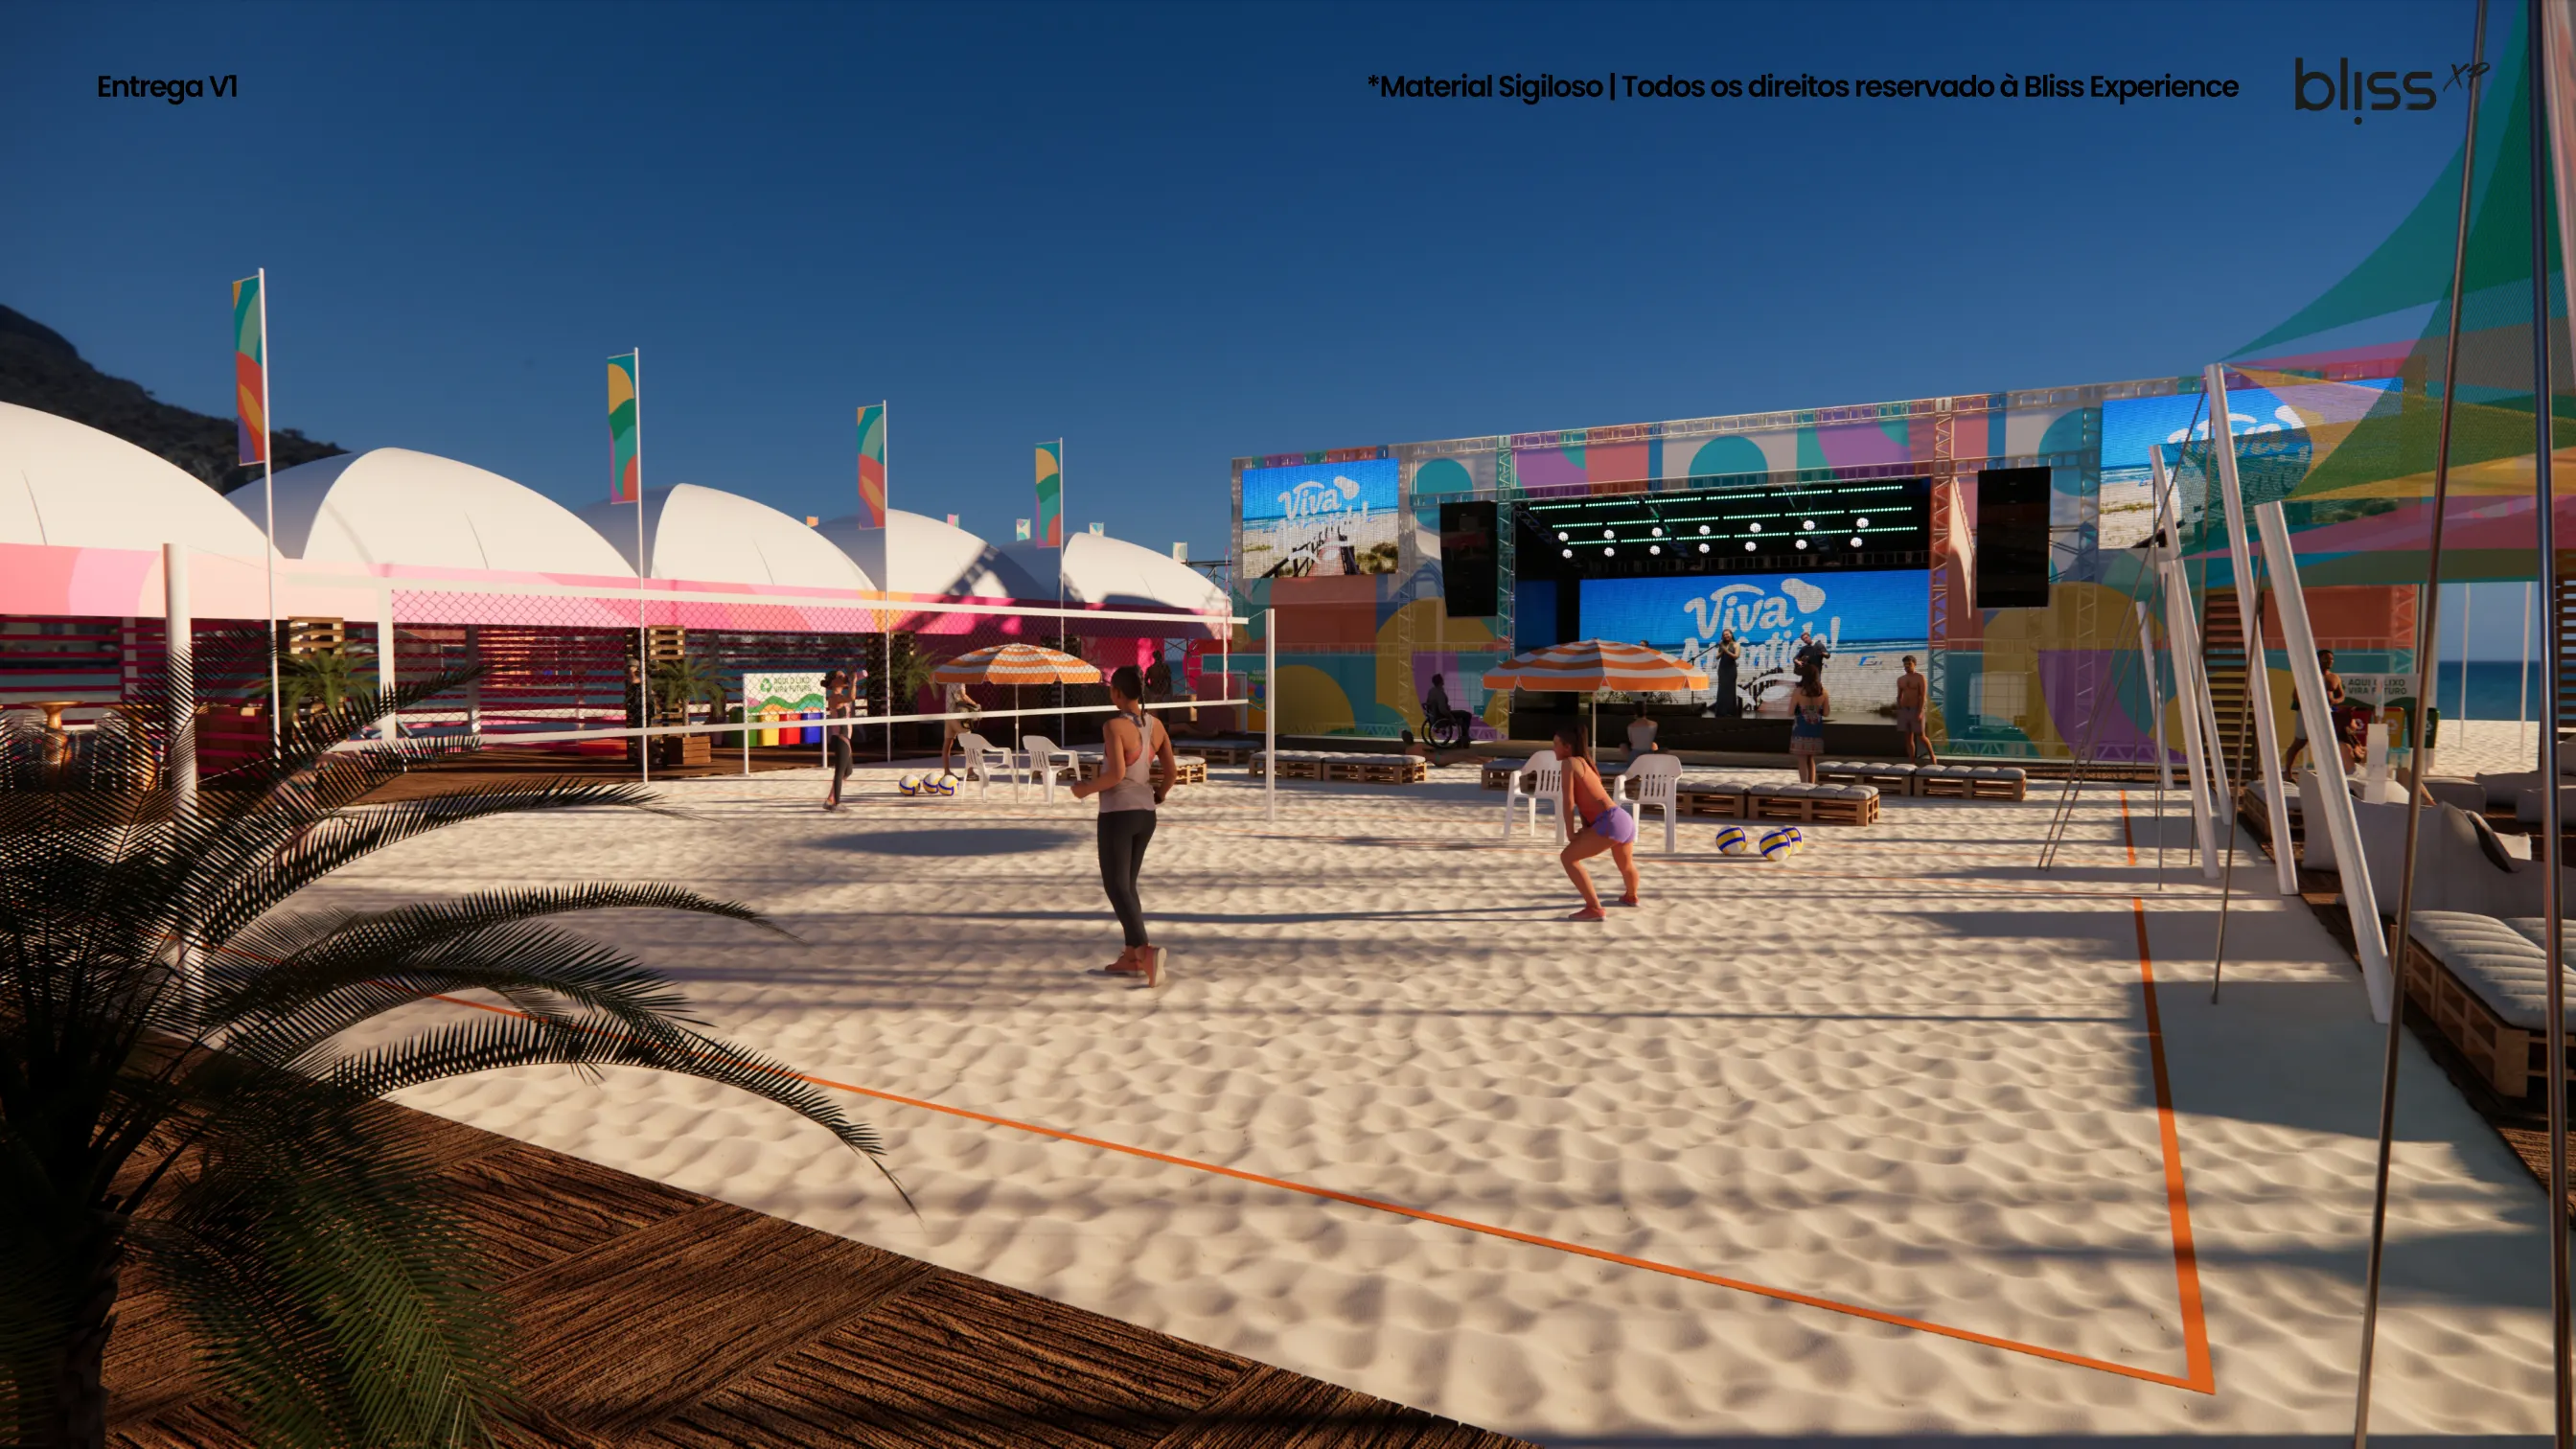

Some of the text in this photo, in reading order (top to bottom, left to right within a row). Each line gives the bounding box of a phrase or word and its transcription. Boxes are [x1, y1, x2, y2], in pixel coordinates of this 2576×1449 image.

[1277, 481, 1343, 520] Viva
[1684, 584, 1794, 639] Viva
[2348, 678, 2371, 687] AQUI
[2384, 678, 2405, 687] LIXO
[2371, 687, 2407, 696] FTURO
